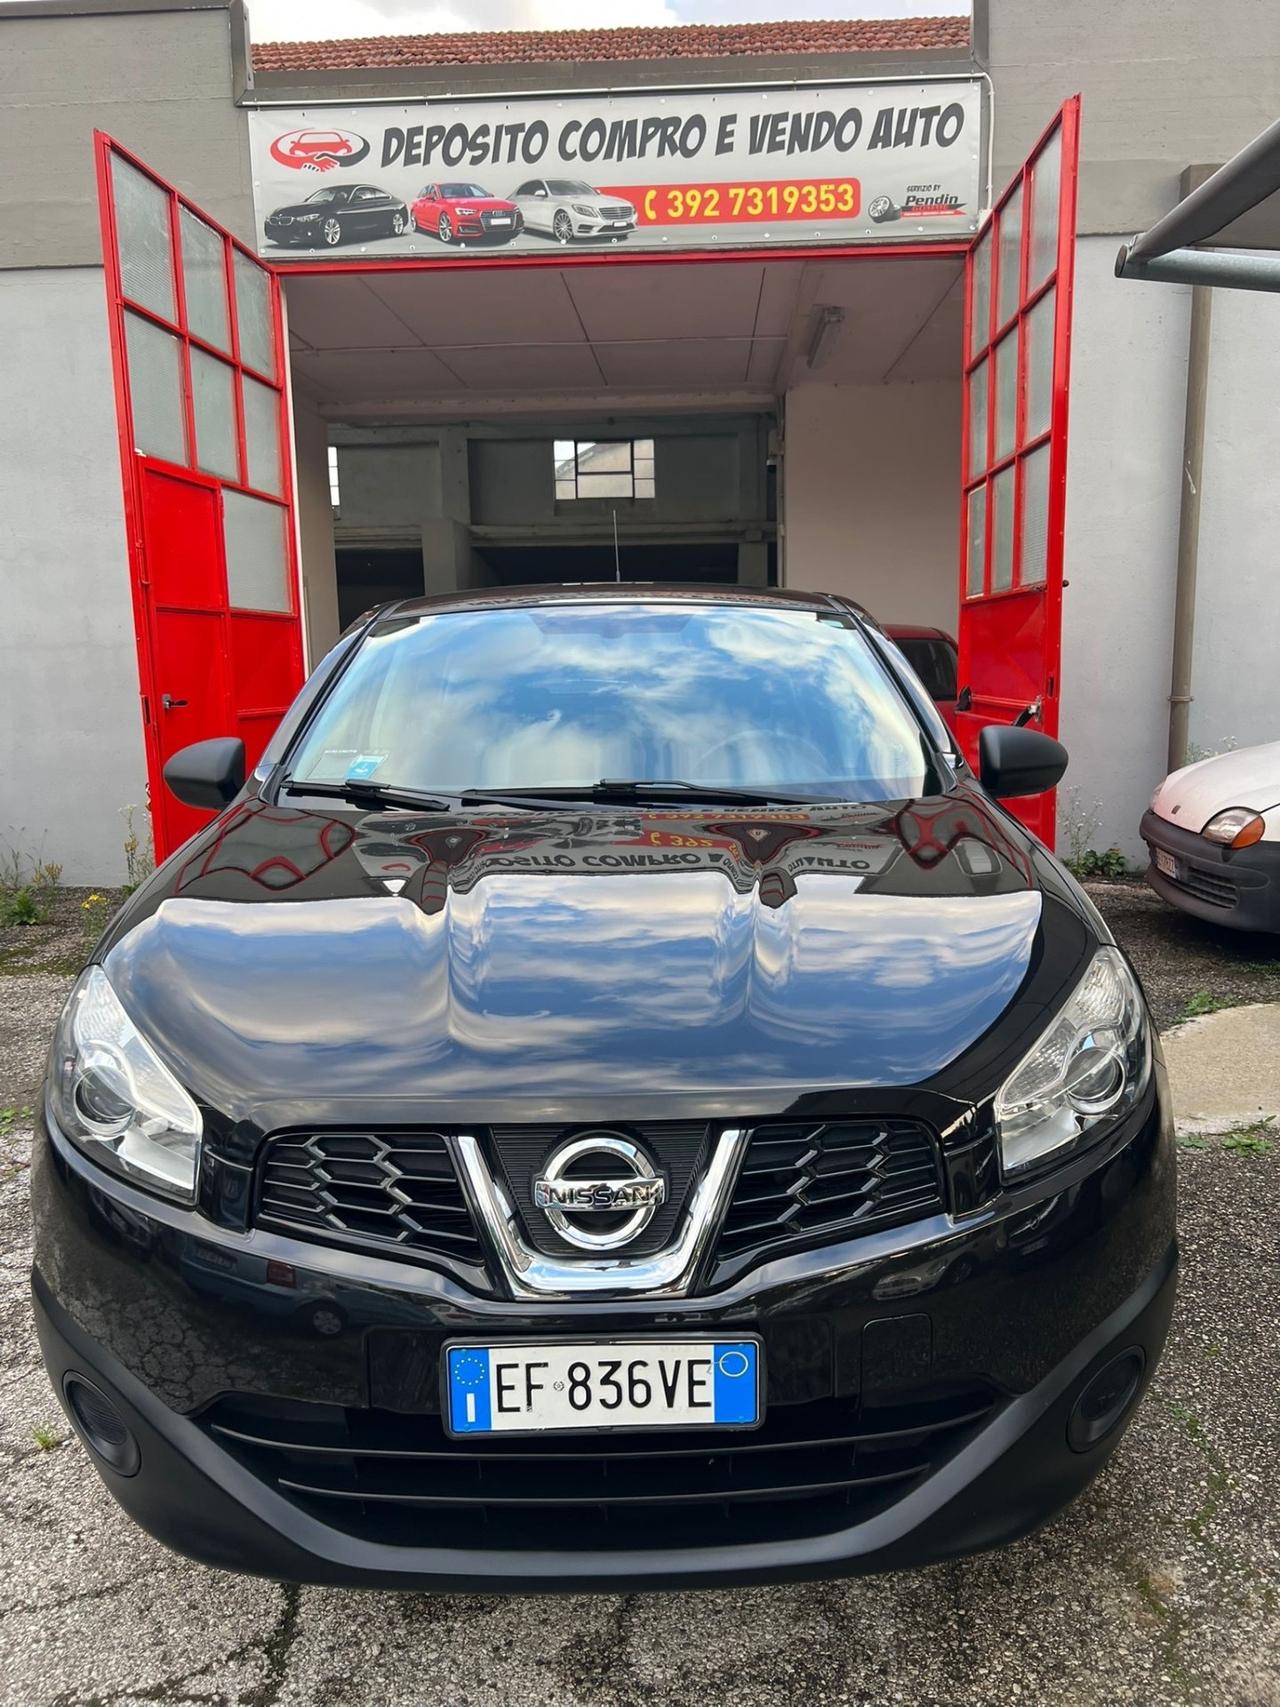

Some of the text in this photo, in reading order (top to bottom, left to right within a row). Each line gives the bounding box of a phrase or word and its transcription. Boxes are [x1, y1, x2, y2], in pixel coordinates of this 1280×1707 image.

[381, 102, 965, 168] DEPOSITO COMPRO E VENDO AUTO
[667, 183, 854, 218] 392 7319353
[905, 194, 959, 206] Pendin
[549, 1184, 655, 1207] NISSAN
[496, 1359, 712, 1413] EF 836VE
